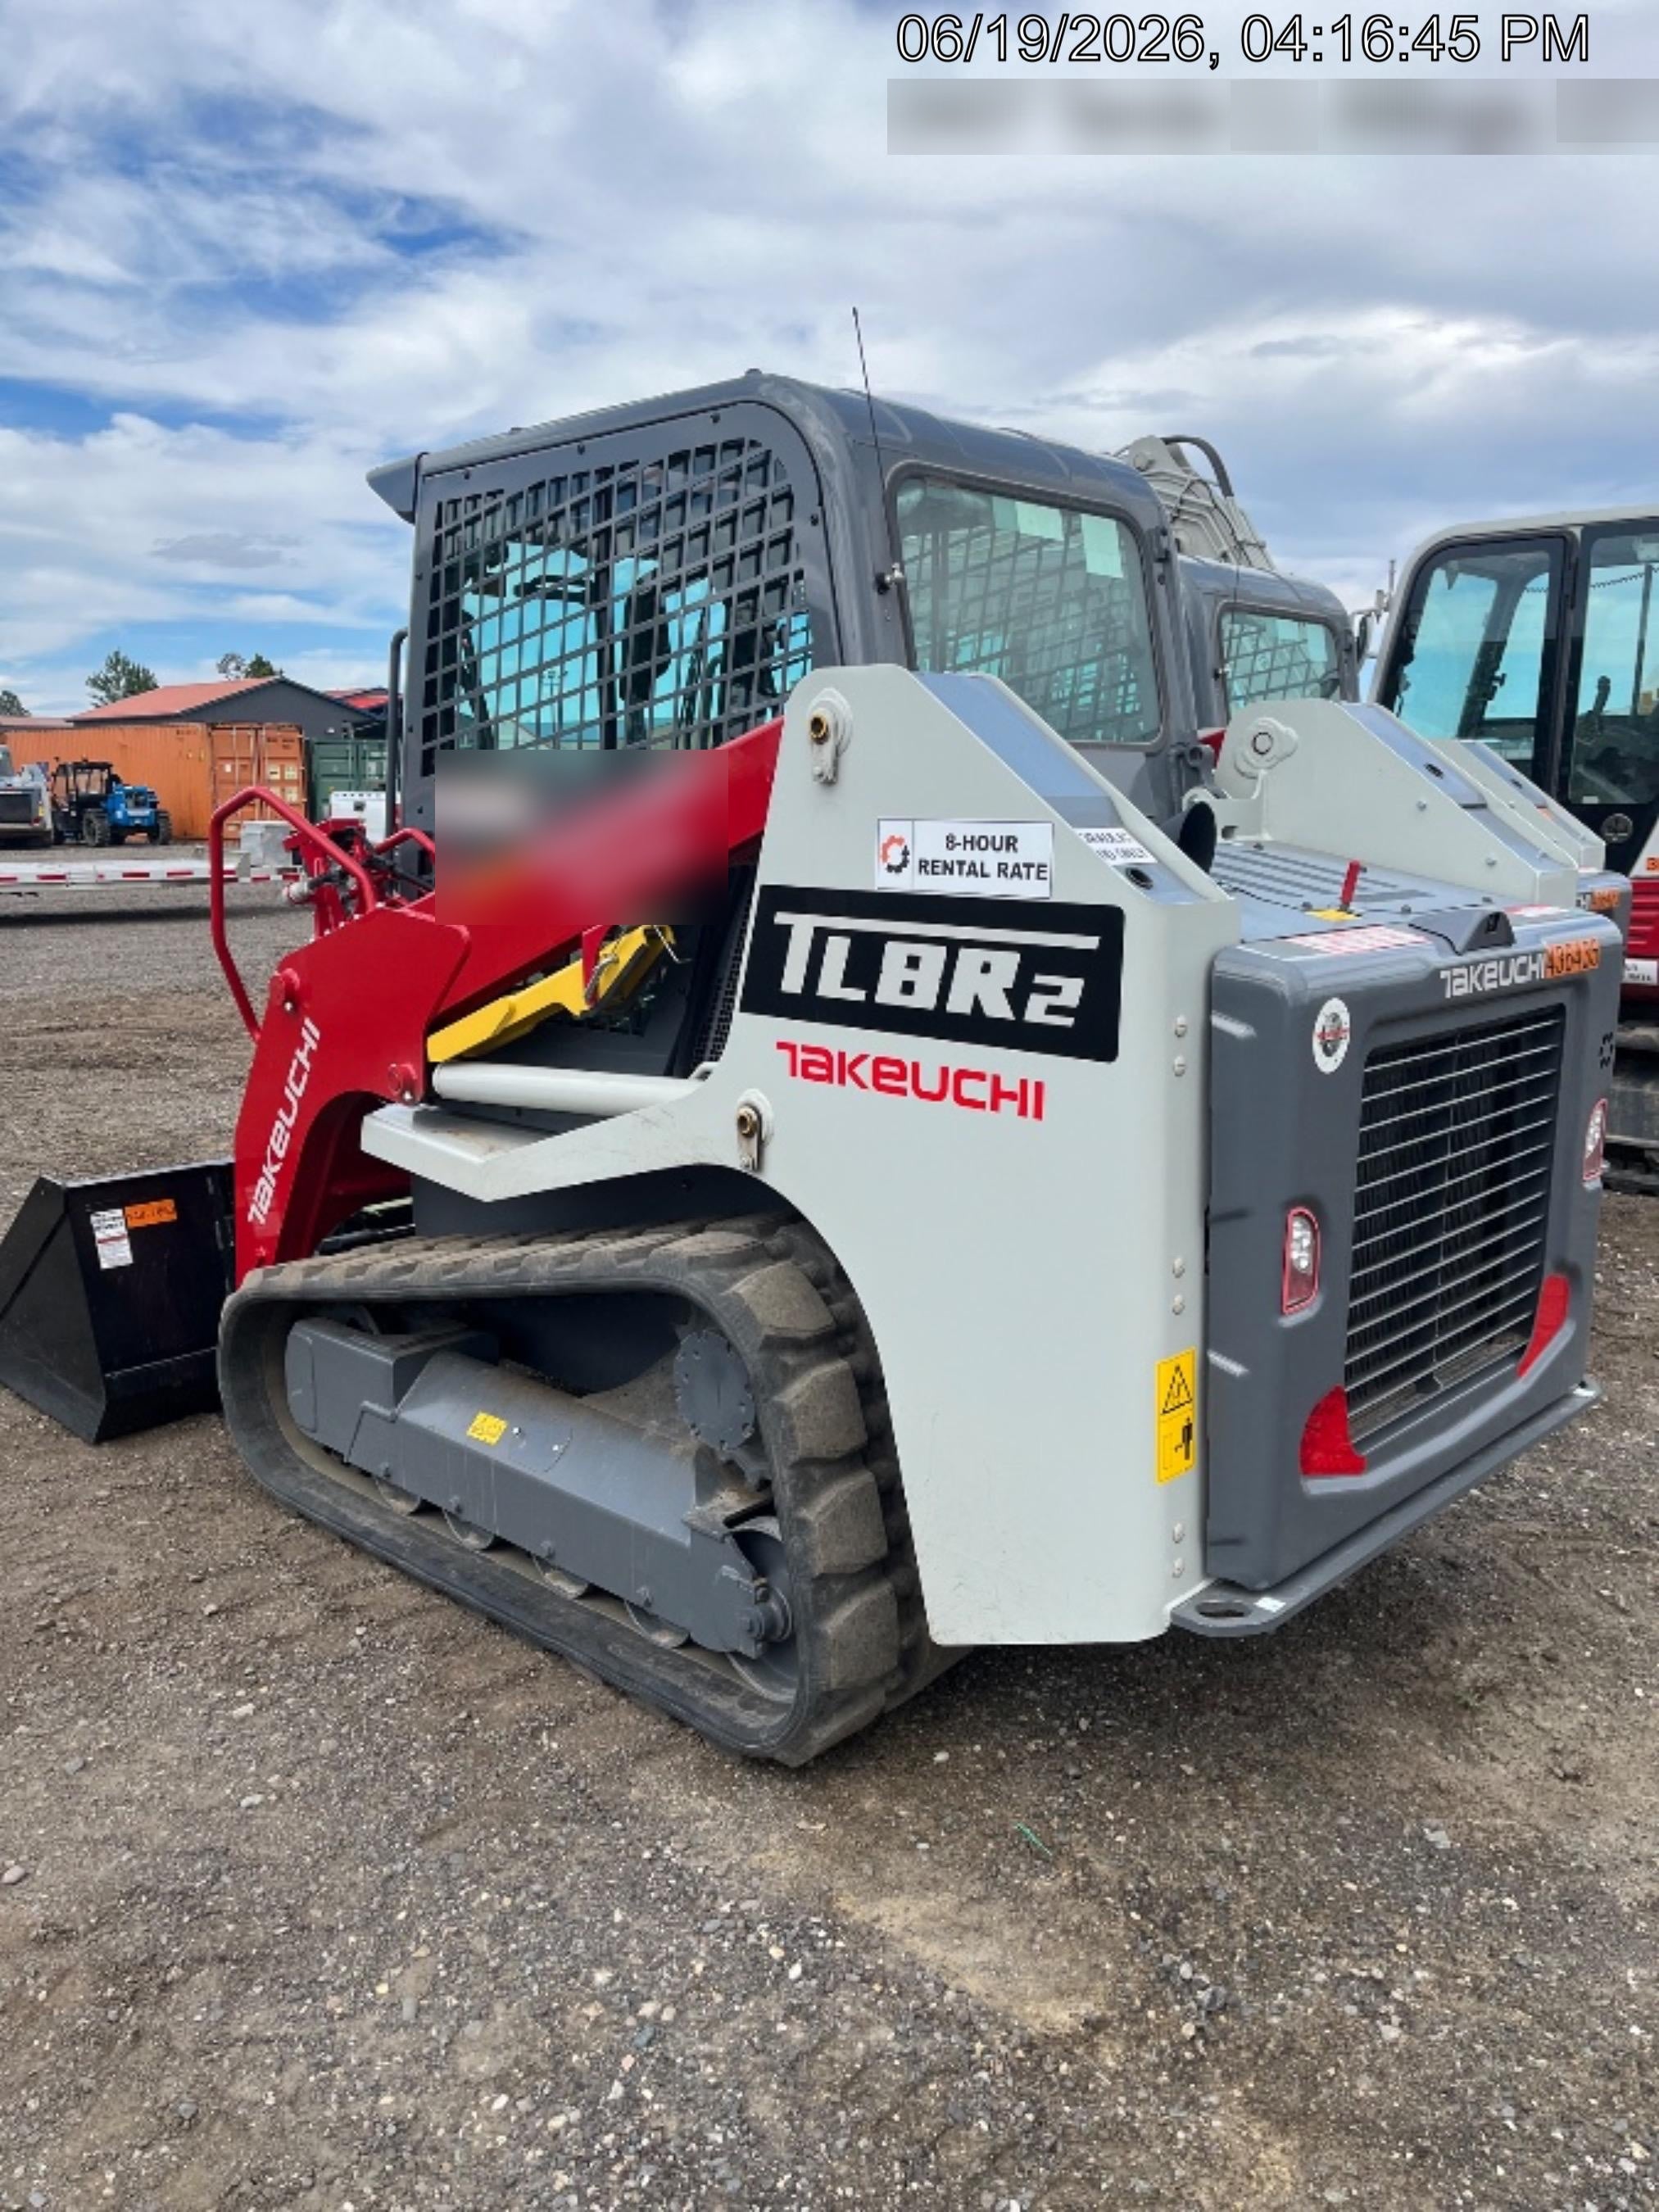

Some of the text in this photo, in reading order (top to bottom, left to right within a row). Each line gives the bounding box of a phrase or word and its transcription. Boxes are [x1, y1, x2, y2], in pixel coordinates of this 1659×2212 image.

[945, 832, 1019, 854] 8-HOUR
[918, 857, 1049, 881] RENTAL RATE
[774, 911, 1102, 1028] TL8R2
